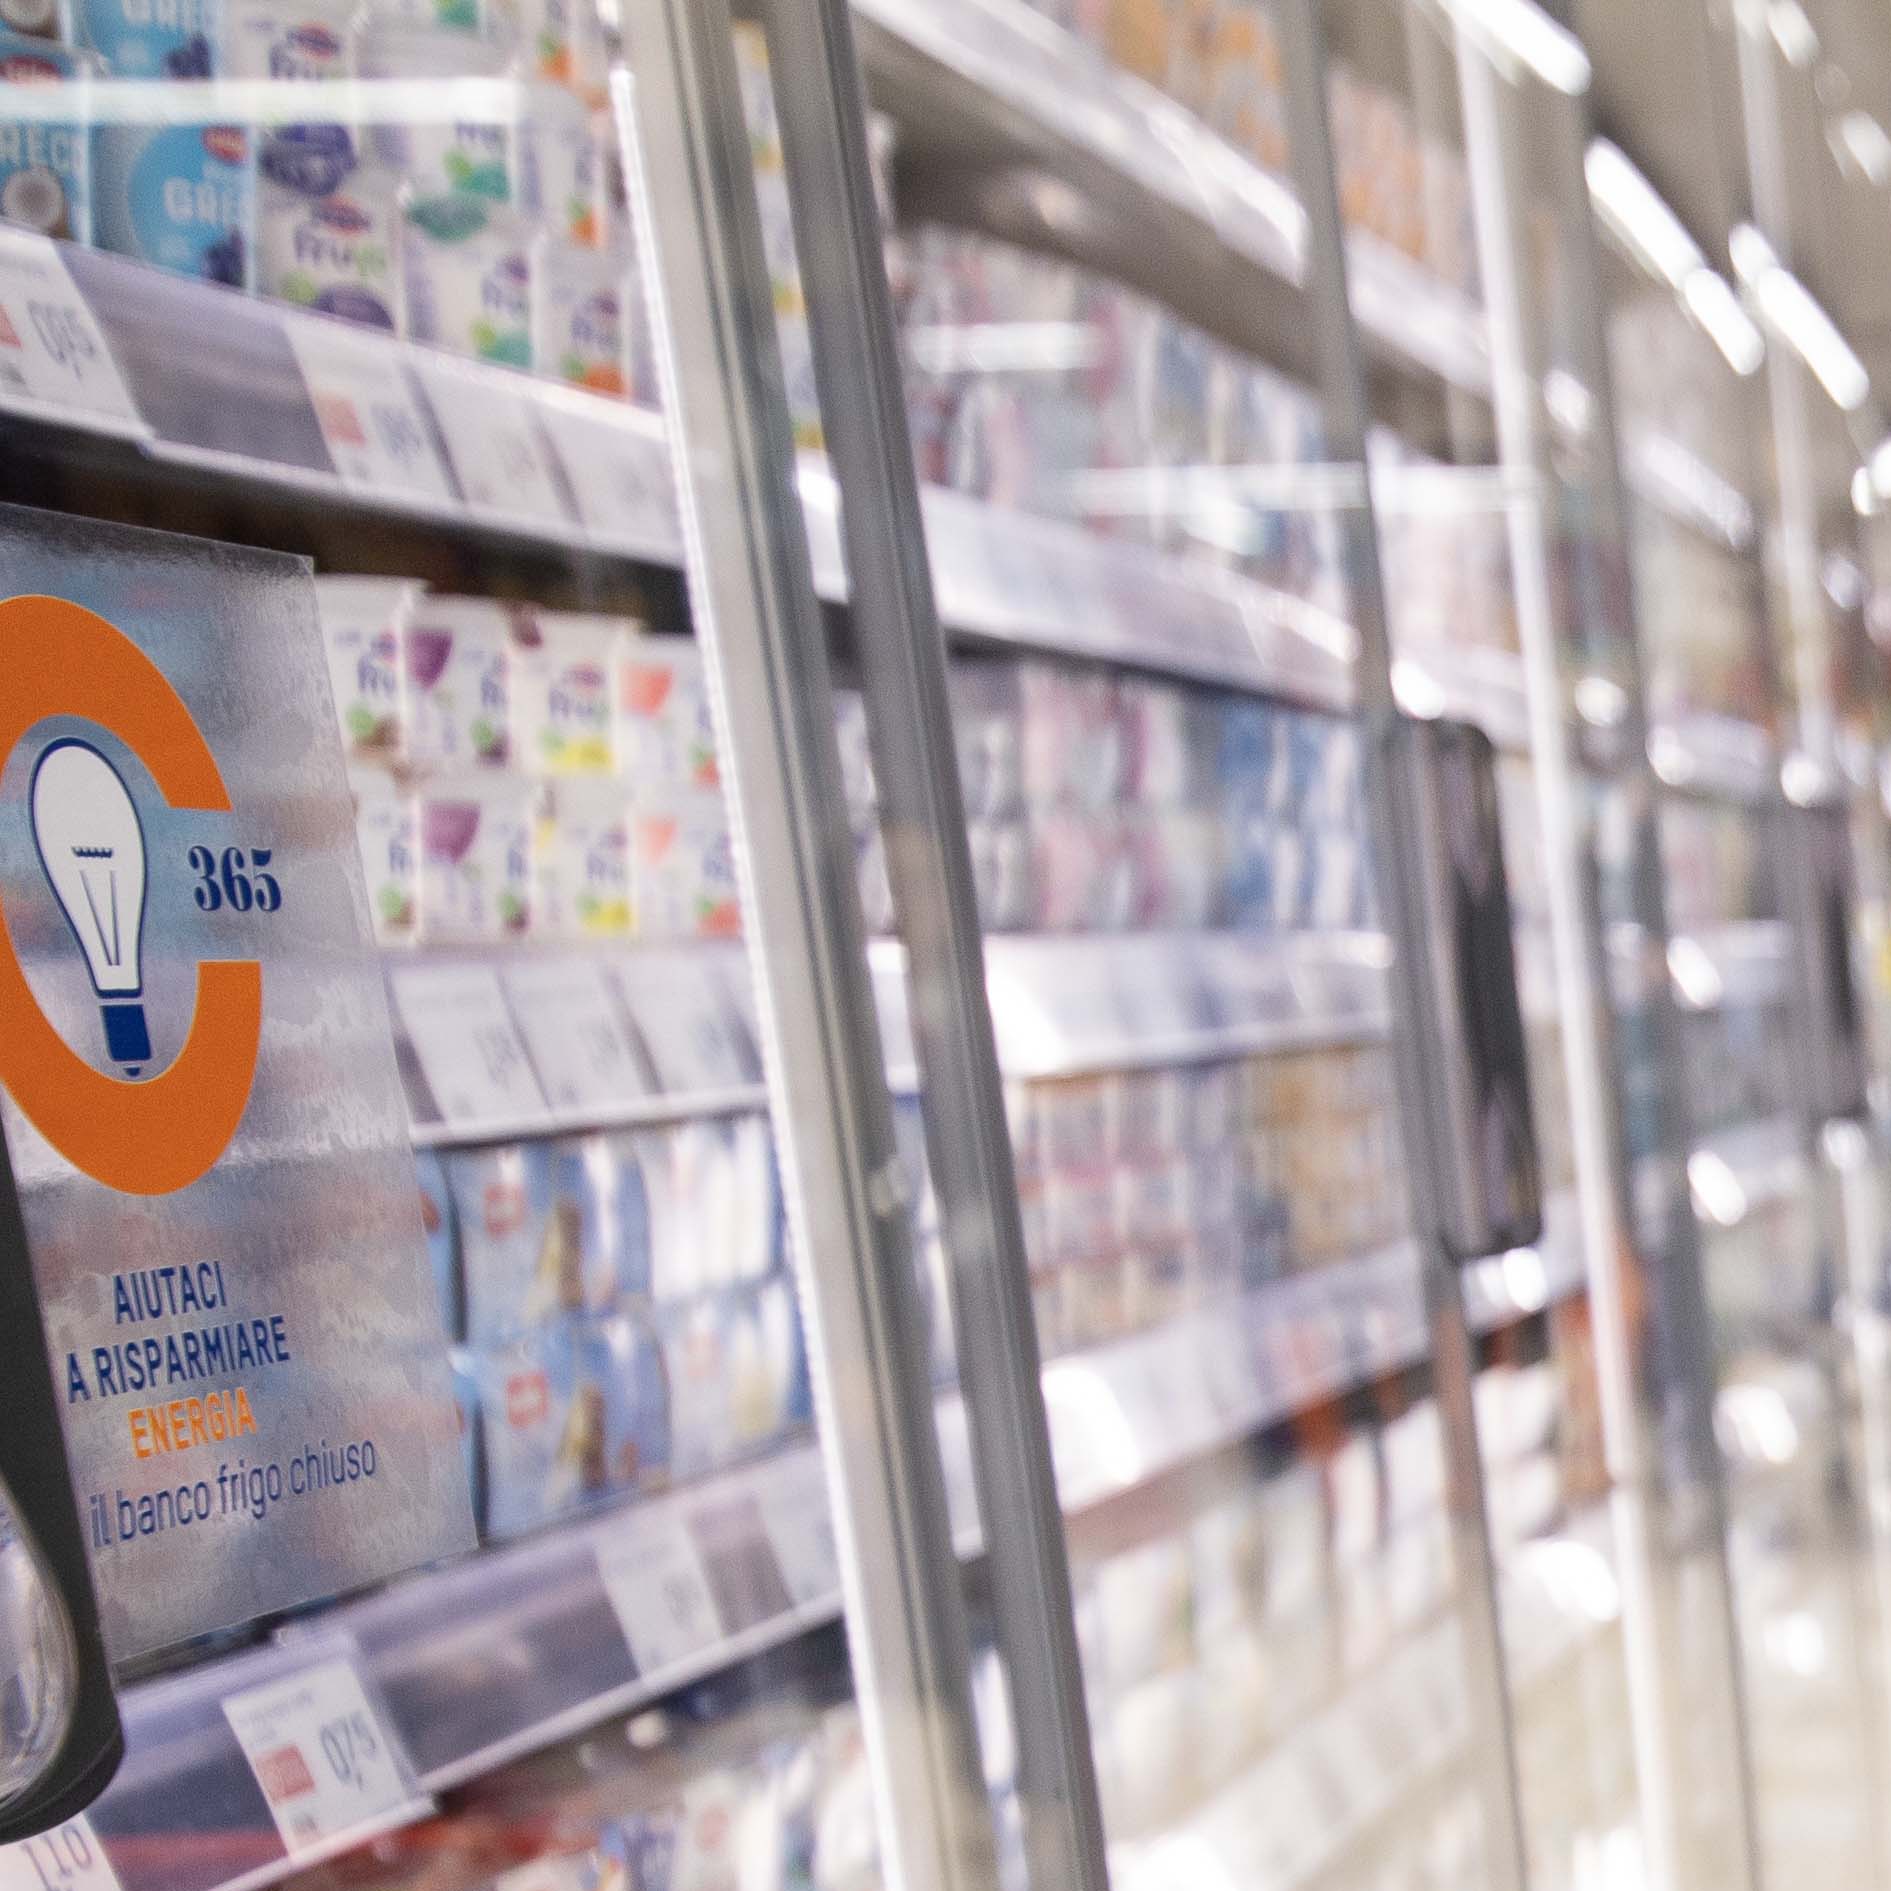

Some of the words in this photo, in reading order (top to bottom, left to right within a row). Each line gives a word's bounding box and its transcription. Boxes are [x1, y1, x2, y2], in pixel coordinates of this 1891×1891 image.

[188, 845, 282, 912] 365
[112, 1260, 227, 1324] AIUTACI
[66, 1351, 91, 1404] A
[93, 1315, 290, 1398] RISPARMIARE
[128, 1387, 257, 1460] ENERGIA
[89, 1494, 112, 1549] il
[117, 1480, 211, 1543] banco
[216, 1462, 282, 1520] frigo
[289, 1439, 377, 1496] chiuso
